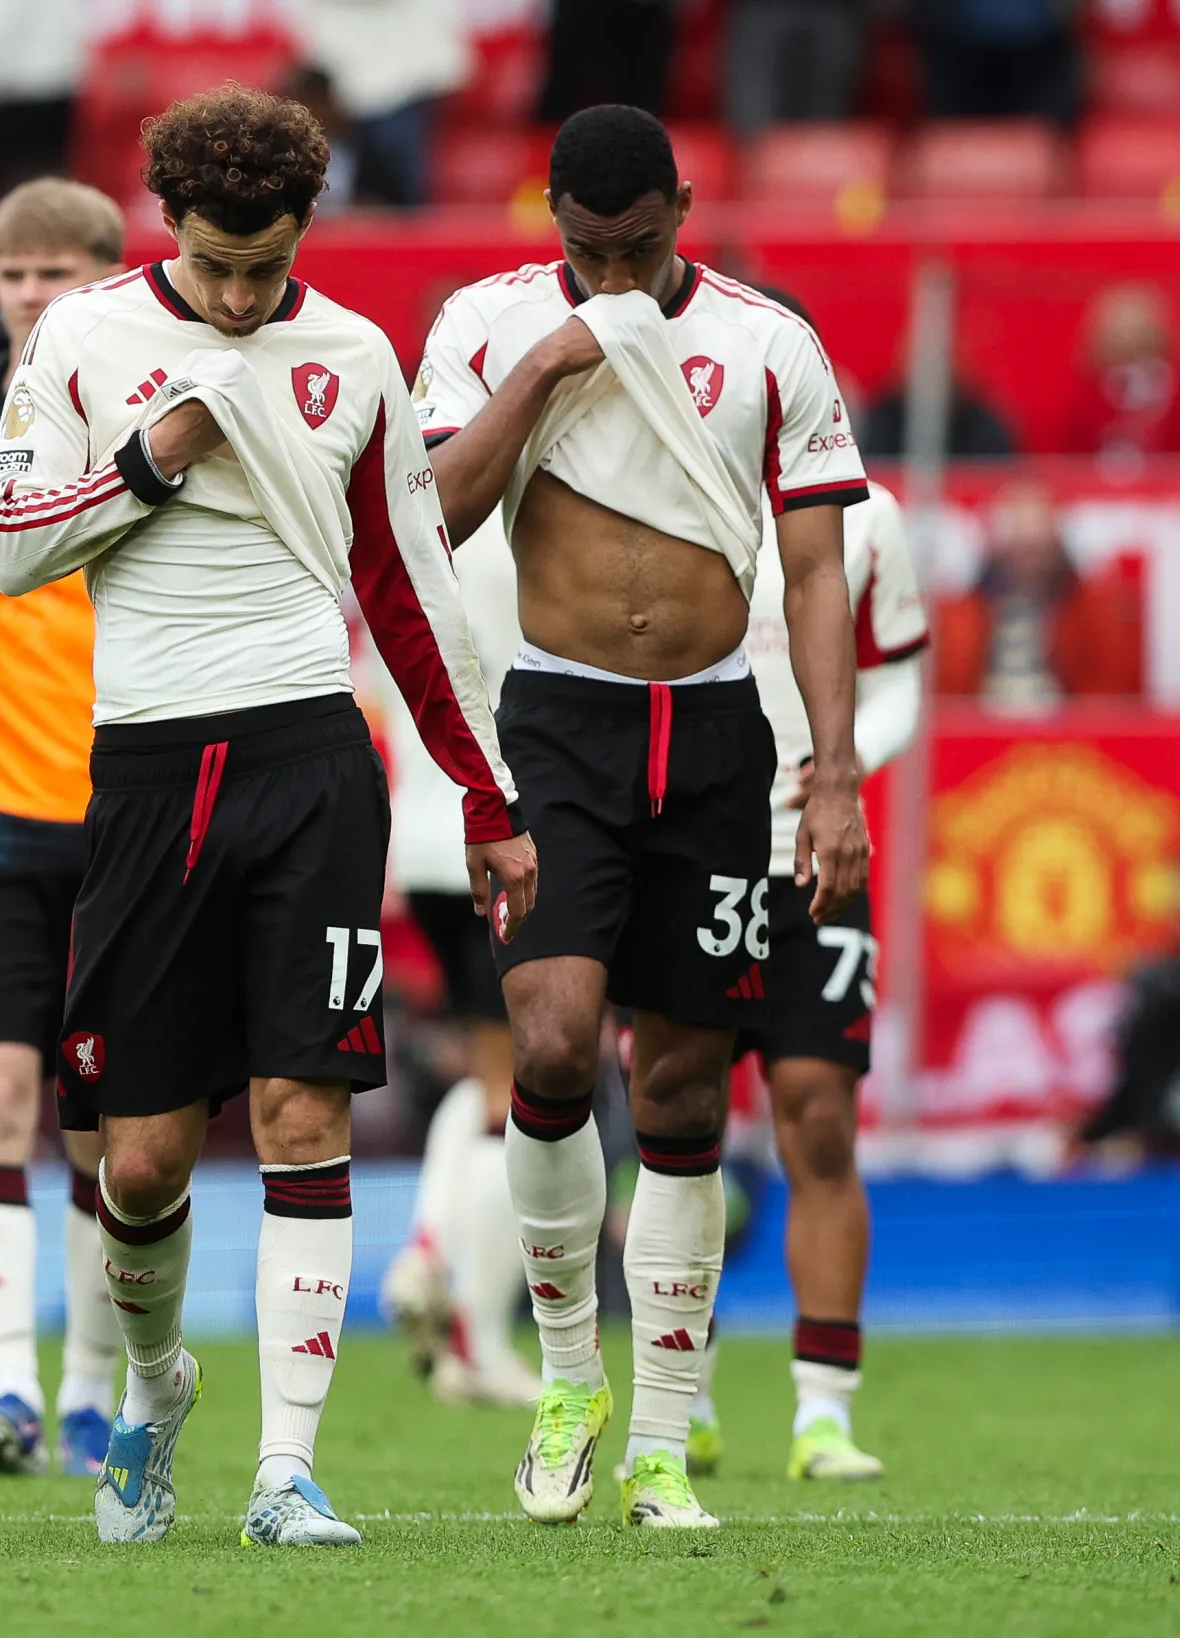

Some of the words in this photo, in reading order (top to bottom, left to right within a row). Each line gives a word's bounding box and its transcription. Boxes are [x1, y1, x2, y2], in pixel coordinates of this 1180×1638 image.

[696, 874, 770, 960] 38
[325, 926, 384, 1012] 17
[519, 1236, 565, 1260] LFC
[104, 1258, 156, 1286] LFC
[292, 1275, 344, 1301] LFC
[652, 1280, 709, 1300] LFC
